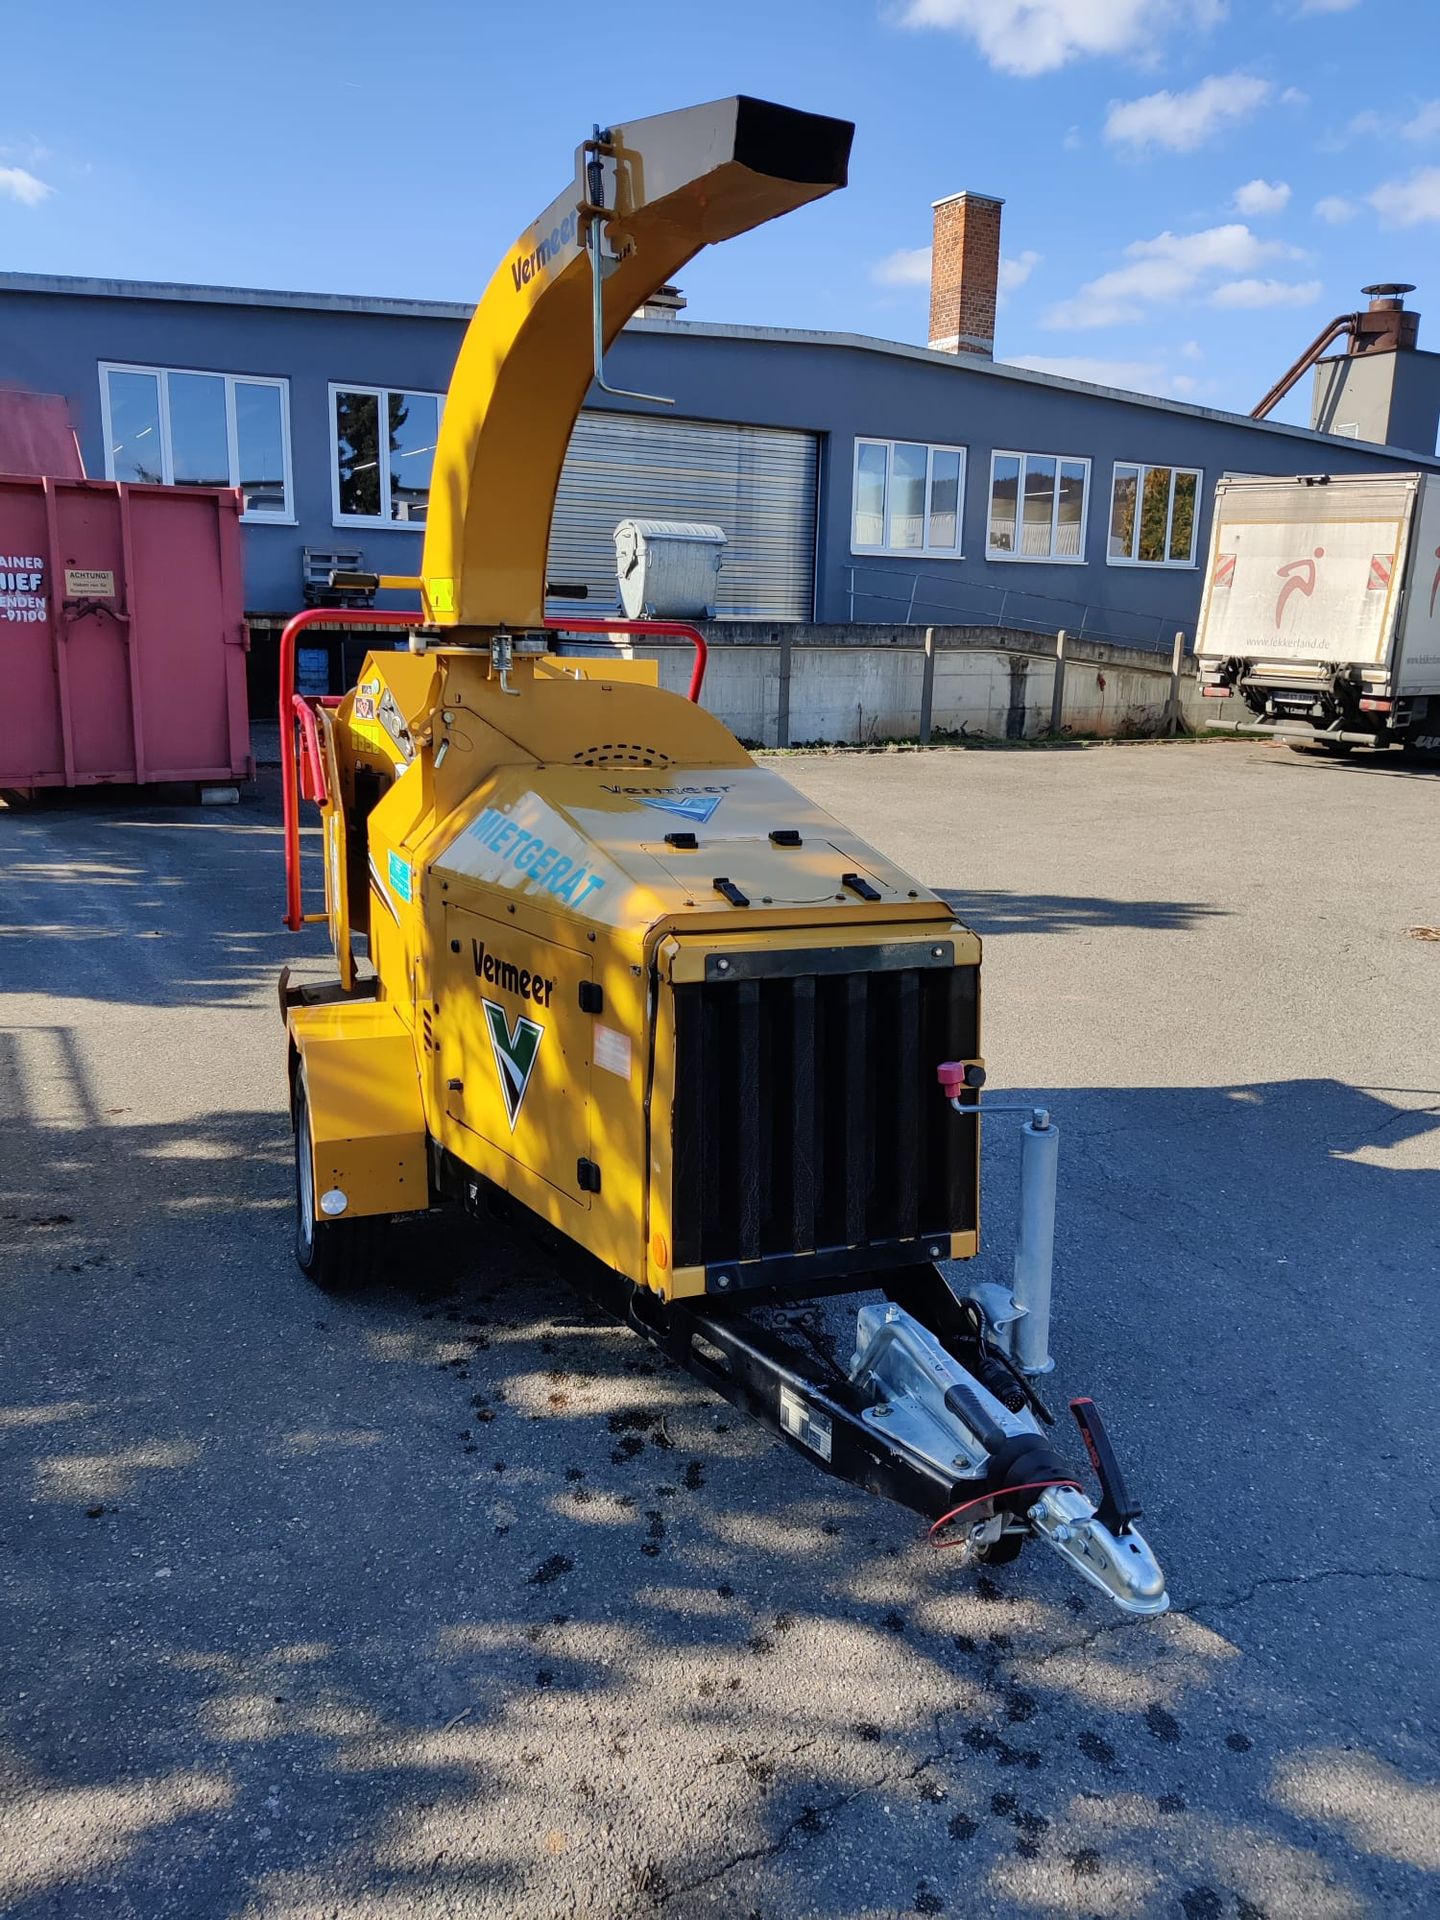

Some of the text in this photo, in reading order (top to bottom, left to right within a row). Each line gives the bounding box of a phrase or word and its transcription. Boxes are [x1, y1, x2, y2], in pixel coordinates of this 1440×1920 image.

[511, 209, 576, 292] Vermeer
[1246, 637, 1330, 650] www.lekkerland.de
[599, 784, 731, 795] Vermeer
[469, 807, 606, 908] MIETGERÄT
[472, 938, 554, 1008] Vermeer
